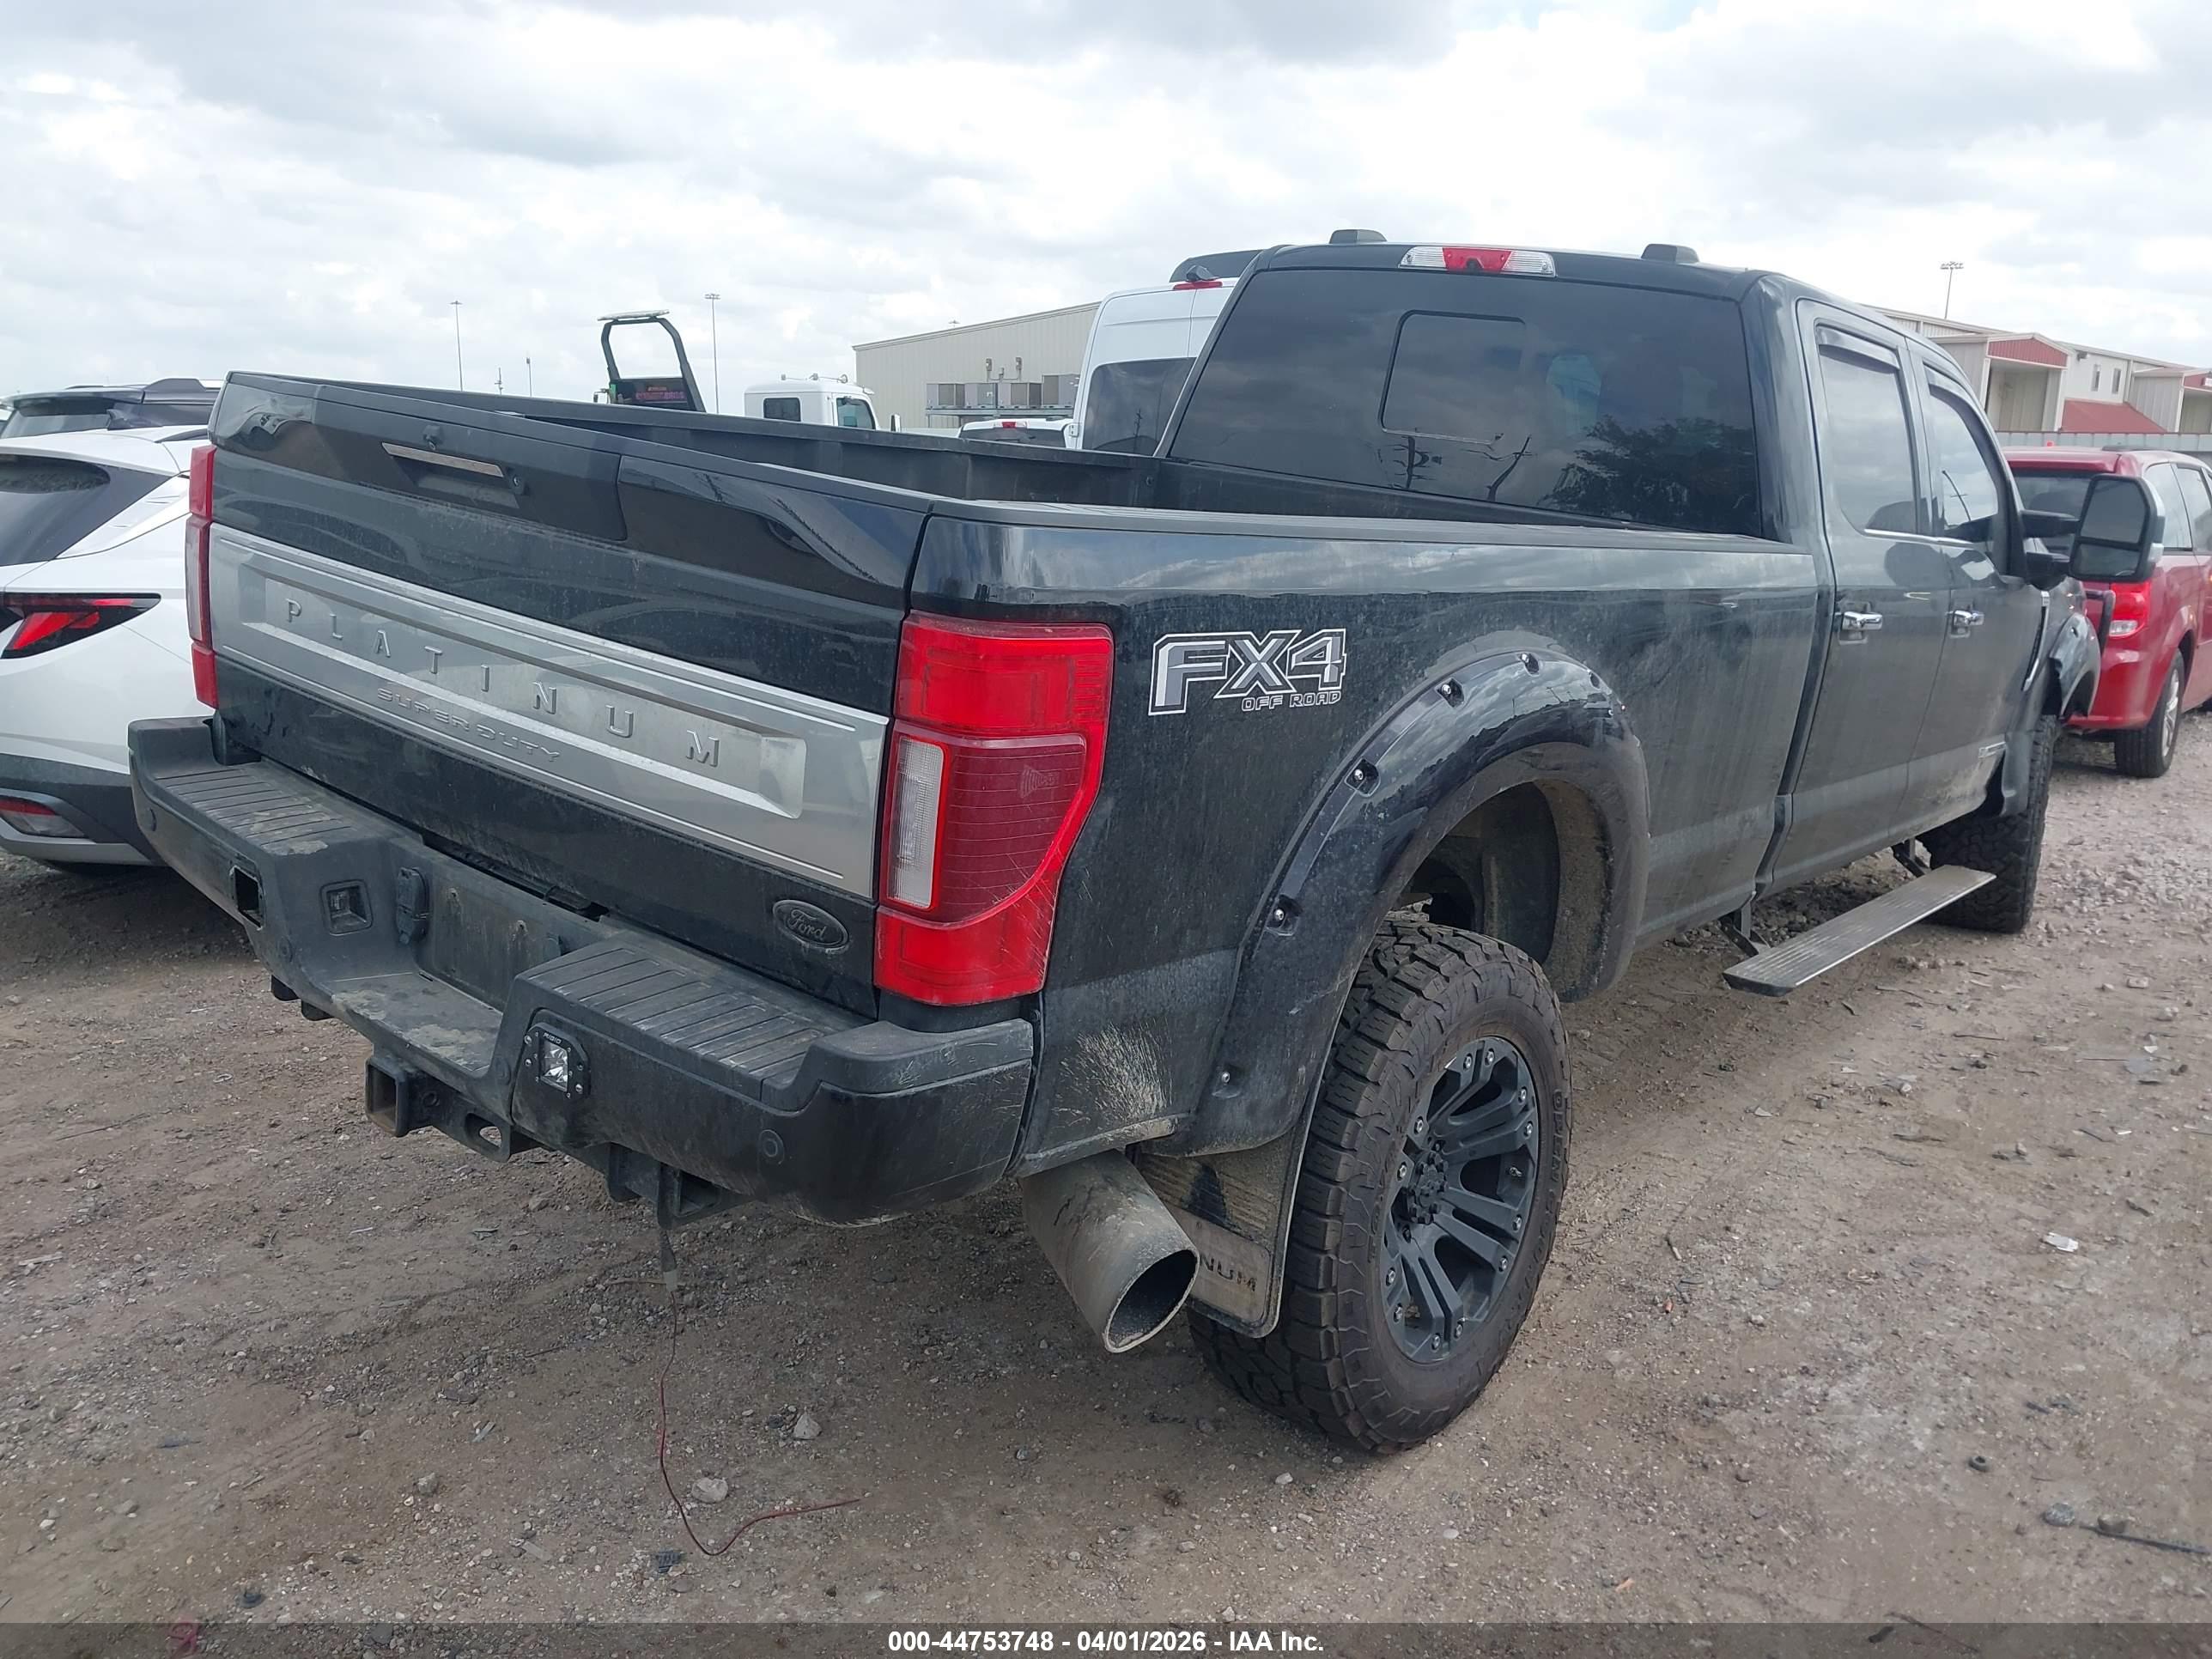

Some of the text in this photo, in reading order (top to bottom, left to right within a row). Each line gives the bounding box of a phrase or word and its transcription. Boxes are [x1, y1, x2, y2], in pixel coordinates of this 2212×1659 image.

[286, 598, 720, 768] PLATINUM
[1148, 629, 1346, 716] FX4
[1241, 690, 1342, 712] OFF ROAD
[377, 687, 561, 763] SUPER DUTY
[787, 908, 828, 941] Ford
